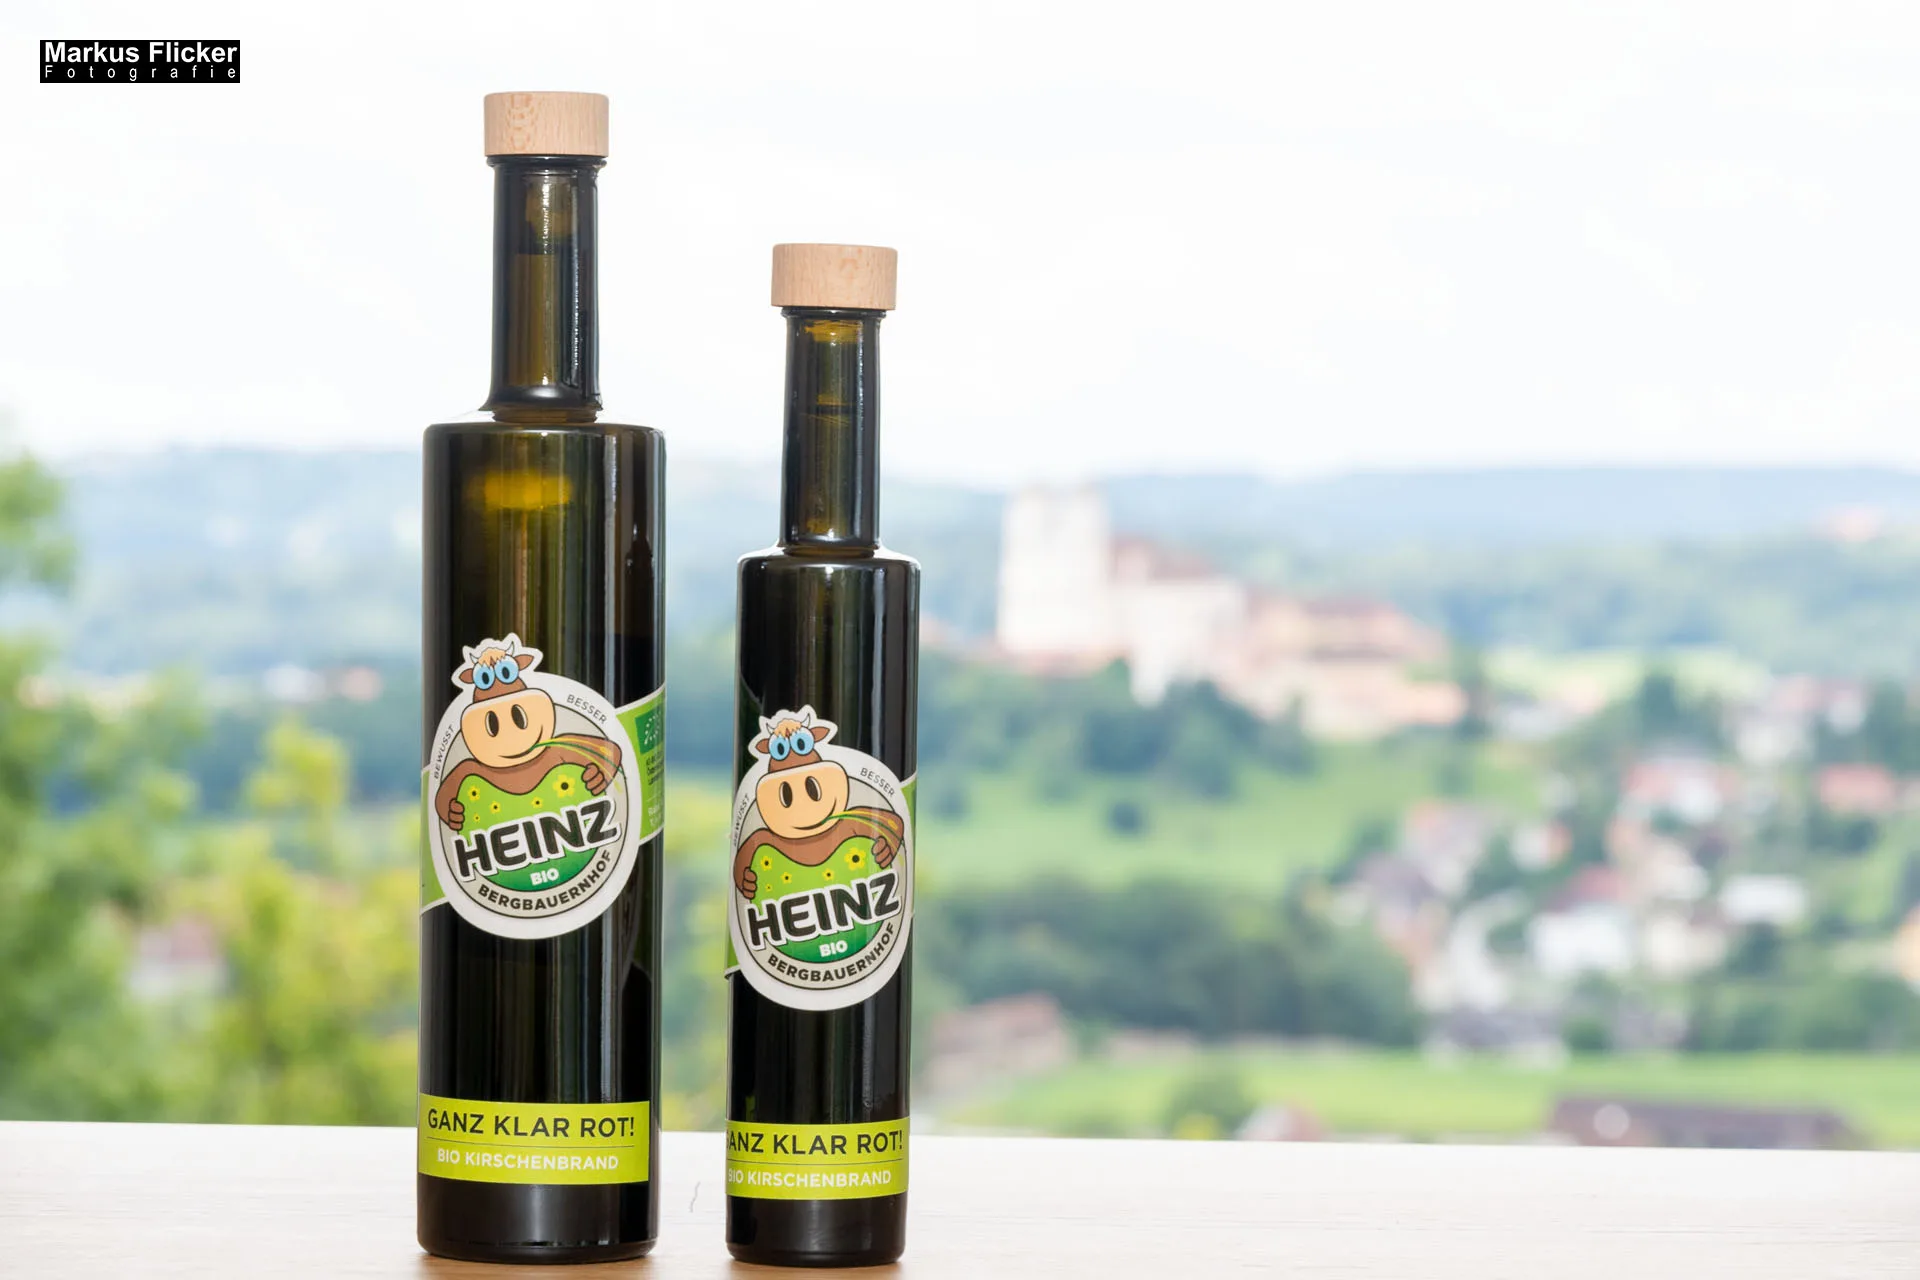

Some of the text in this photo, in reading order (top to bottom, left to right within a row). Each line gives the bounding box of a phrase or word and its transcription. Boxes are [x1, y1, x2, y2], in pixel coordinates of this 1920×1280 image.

[566, 694, 607, 724] BESSER
[434, 724, 455, 779] BEWUSST
[860, 767, 895, 797] BESSER
[454, 800, 617, 878] HEINZ
[477, 849, 612, 911] BERGBAUERNHOF
[530, 867, 560, 886] BIO
[747, 873, 900, 946] HEINZ
[767, 922, 894, 982] BERGBAUERNHOF
[819, 940, 848, 957] BIO
[428, 1108, 634, 1137] GANZ KLAR ROT!
[727, 1130, 903, 1155] ANZ KLAR ROT!
[437, 1148, 619, 1170] BIO KIRSCHENBRAND
[728, 1169, 891, 1187] BIO KIRSCHENBRAND
